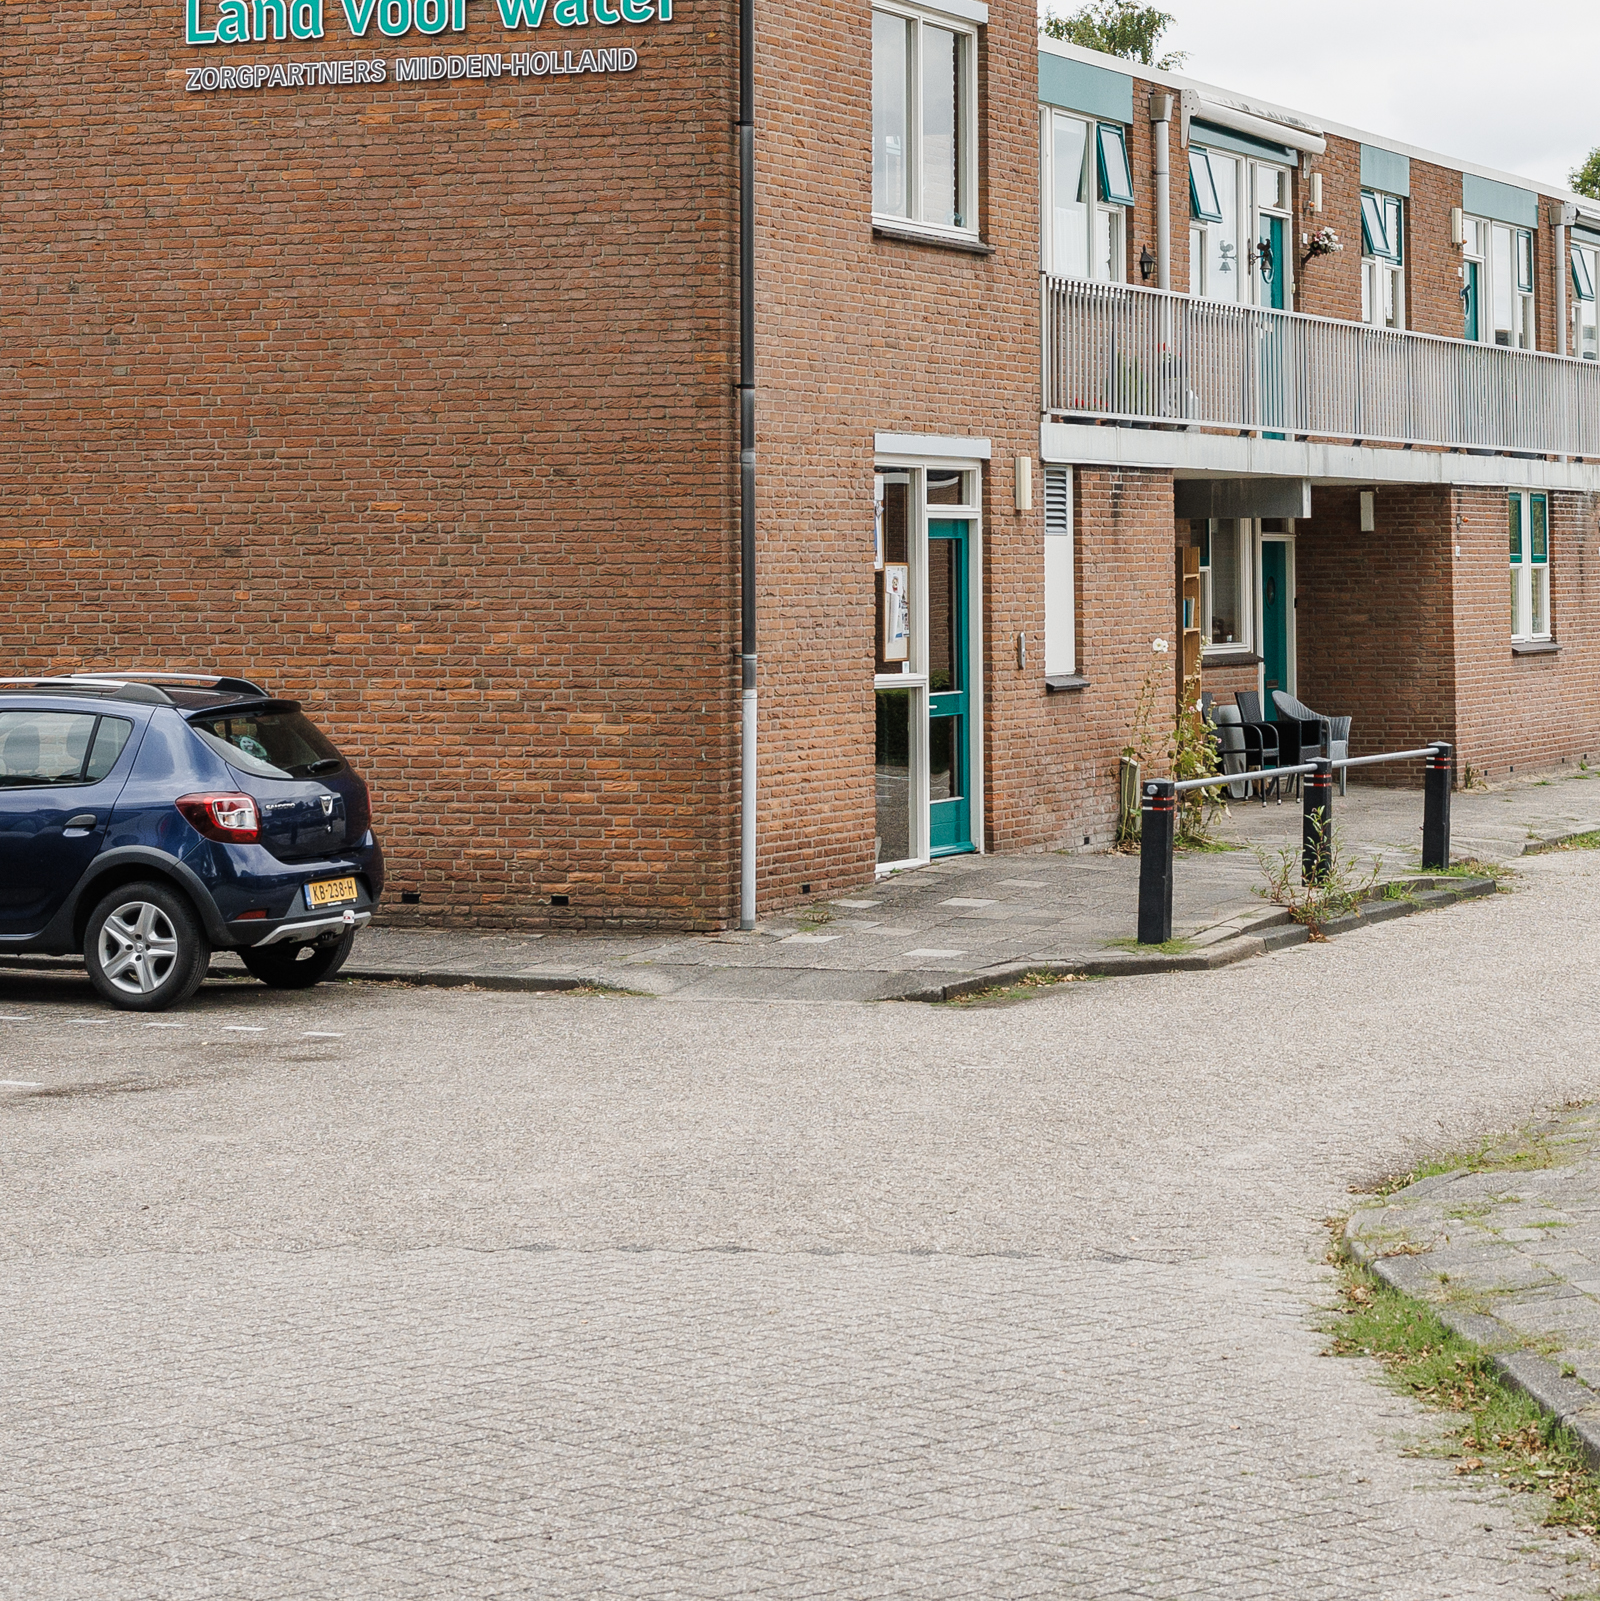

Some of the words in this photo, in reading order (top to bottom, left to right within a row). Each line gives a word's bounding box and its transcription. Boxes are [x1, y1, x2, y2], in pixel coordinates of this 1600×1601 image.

[186, 58, 387, 91] ZORGPARTNERS
[395, 47, 638, 82] MIDDEN-HOLLAND
[312, 880, 354, 902] KB-238-H
